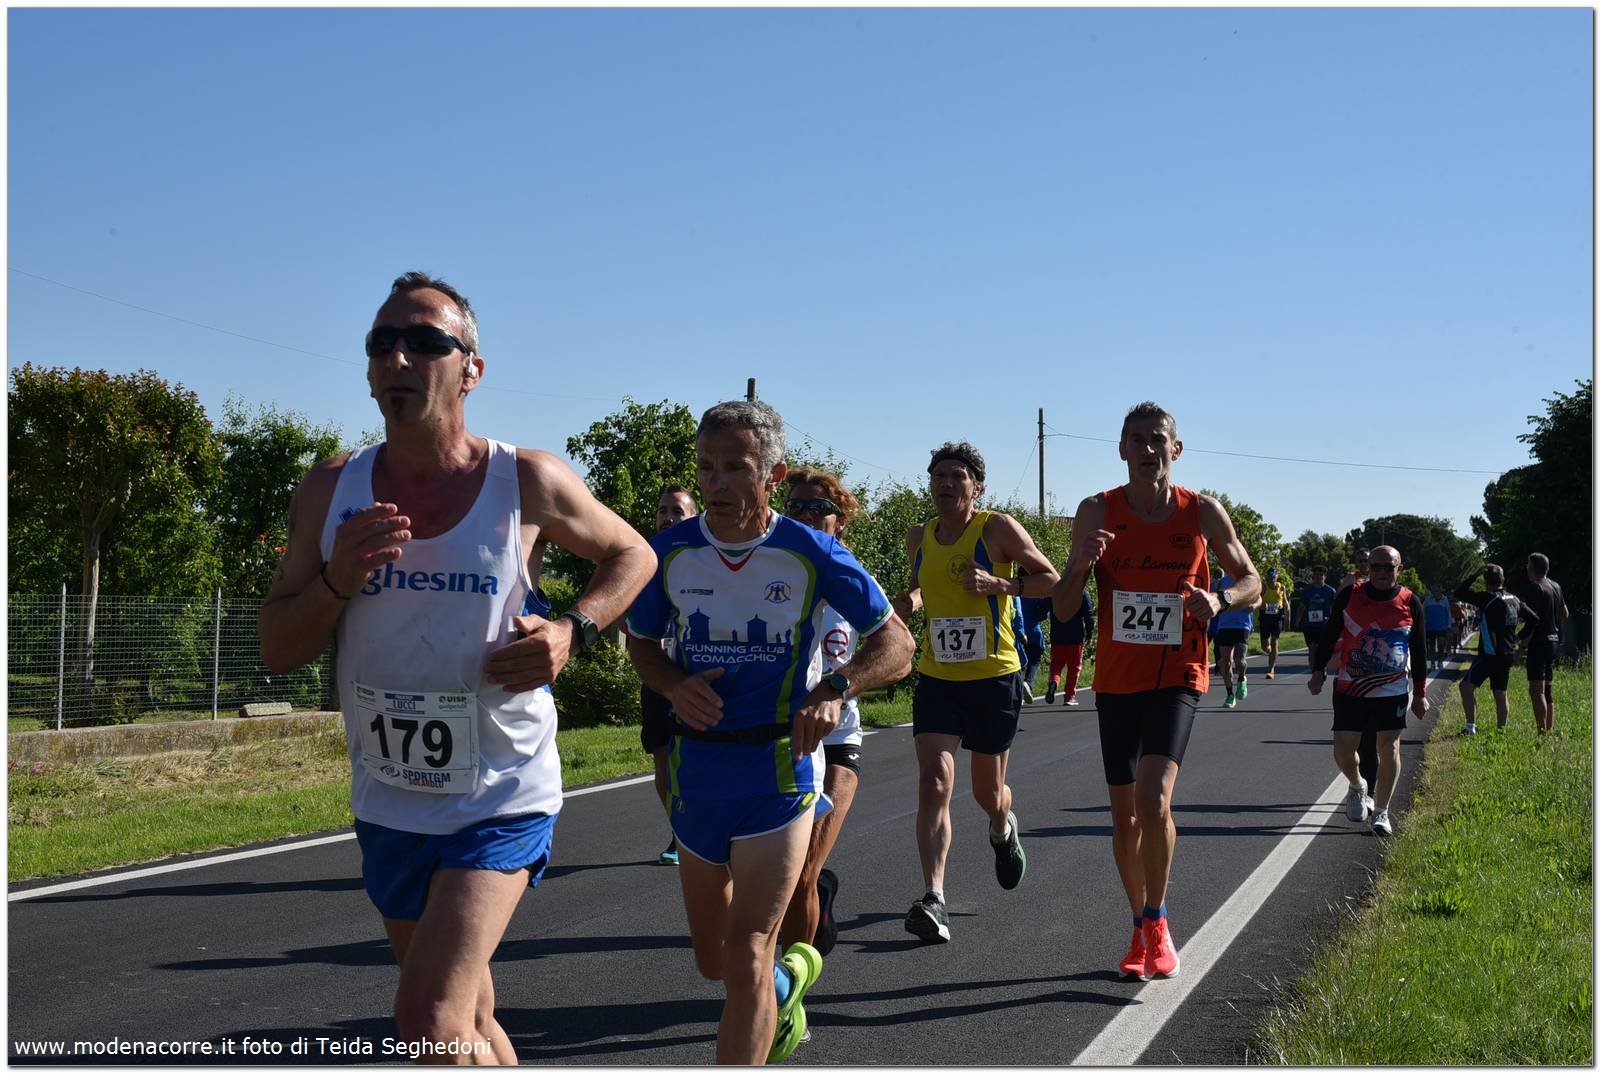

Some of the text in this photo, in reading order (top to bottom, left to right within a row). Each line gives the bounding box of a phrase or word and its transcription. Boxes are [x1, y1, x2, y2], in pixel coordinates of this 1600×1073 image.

[1122, 605, 1171, 631] 247
[937, 629, 976, 651] 137
[685, 643, 786, 654] RUNNING CLUB
[692, 654, 777, 664] COMACCHIO
[392, 699, 416, 710] LUCCI
[370, 713, 453, 769] 179
[402, 768, 451, 782] SPORTGM
